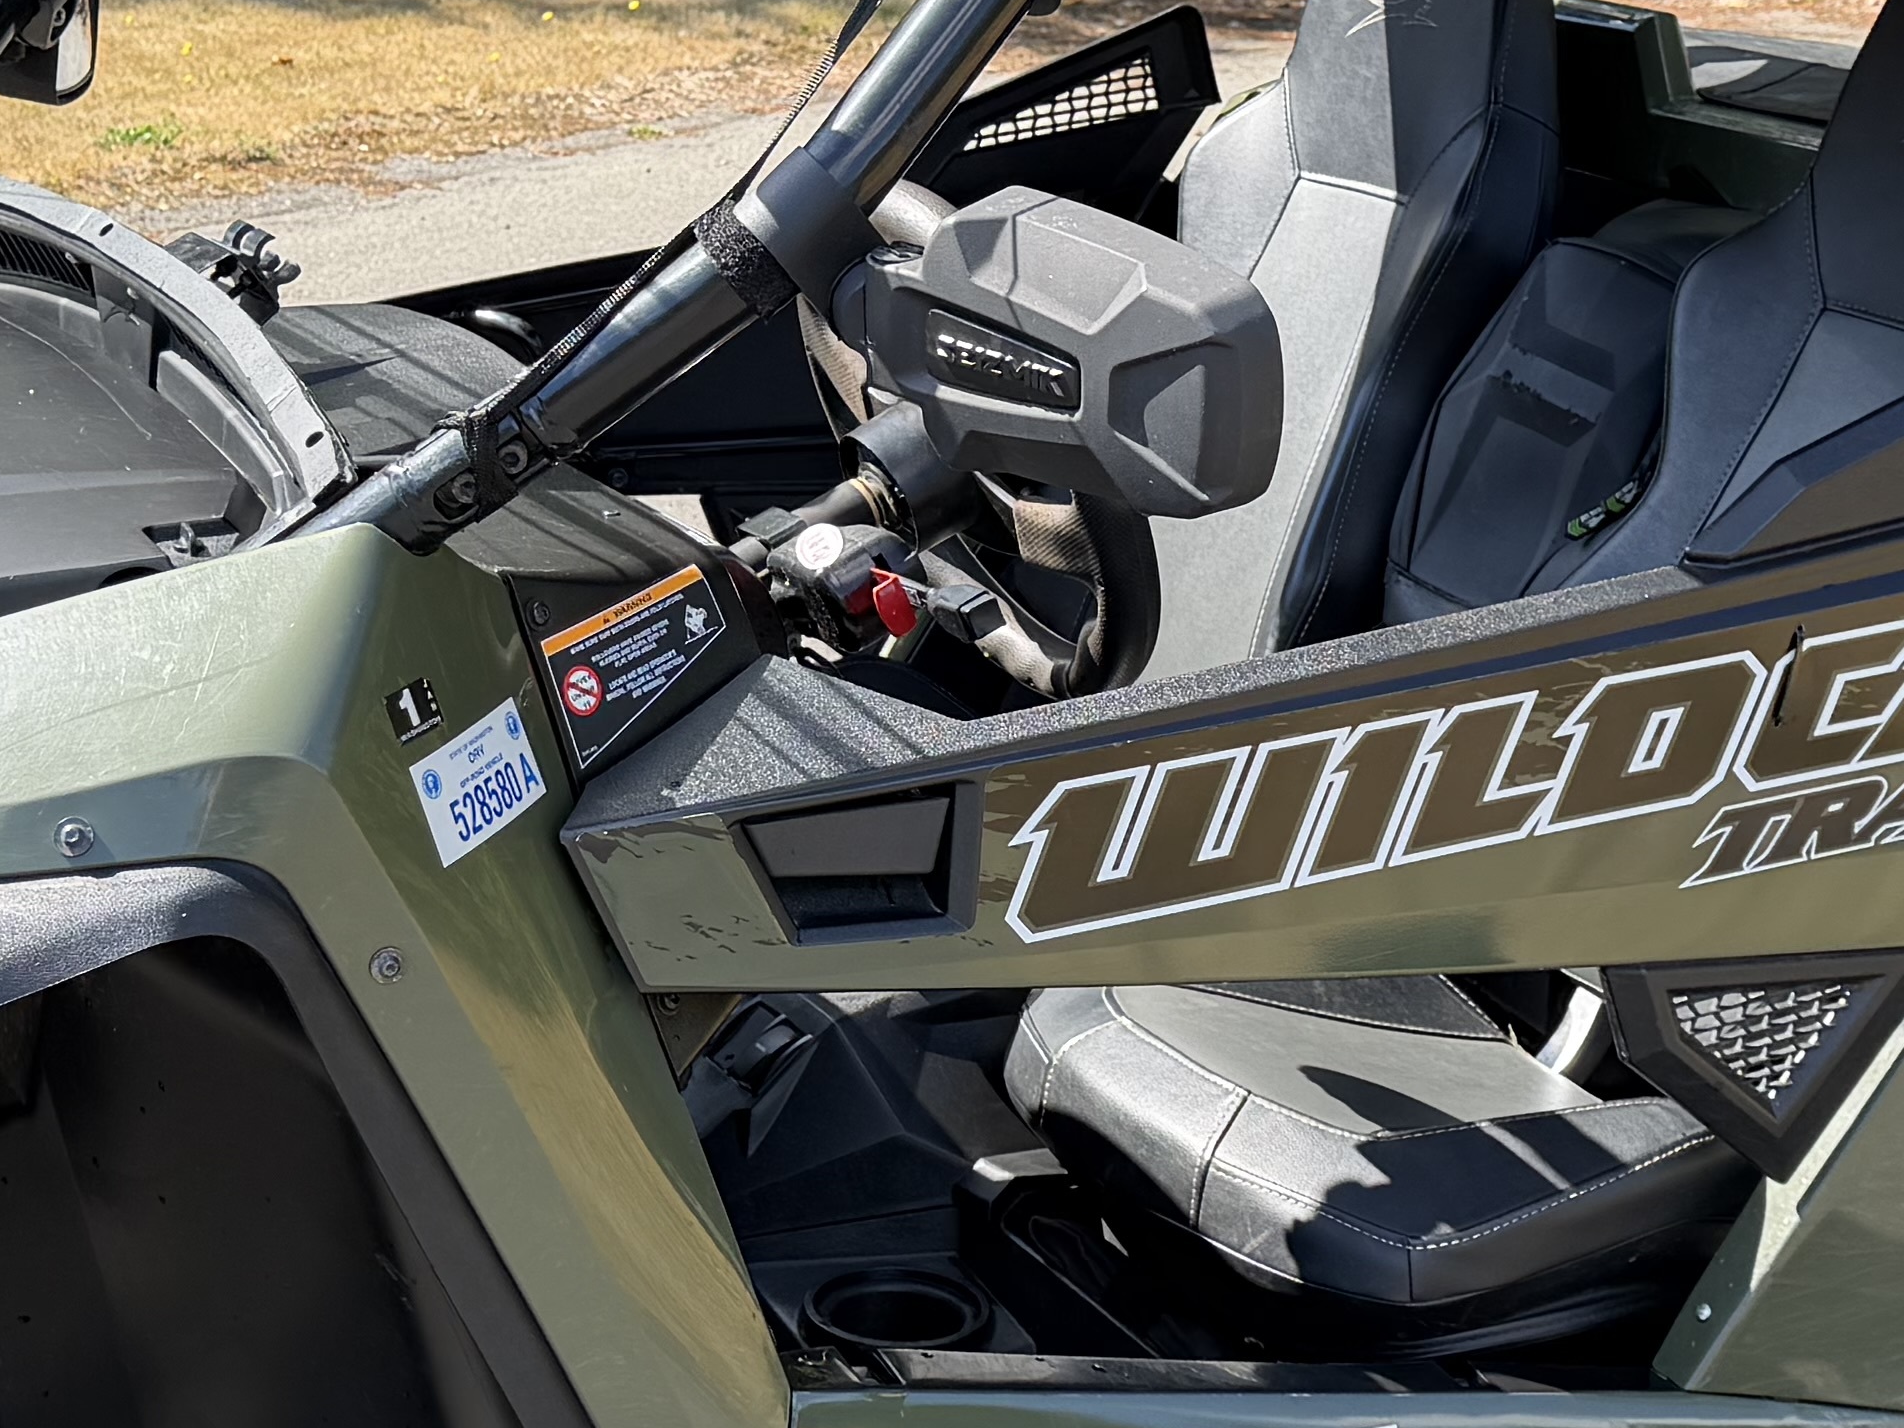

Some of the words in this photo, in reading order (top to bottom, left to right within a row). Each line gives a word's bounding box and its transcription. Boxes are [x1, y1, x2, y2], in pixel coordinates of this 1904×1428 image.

[399, 688, 421, 727] 1
[468, 744, 485, 763] ORV
[449, 761, 523, 842] 528580
[519, 752, 540, 794] A
